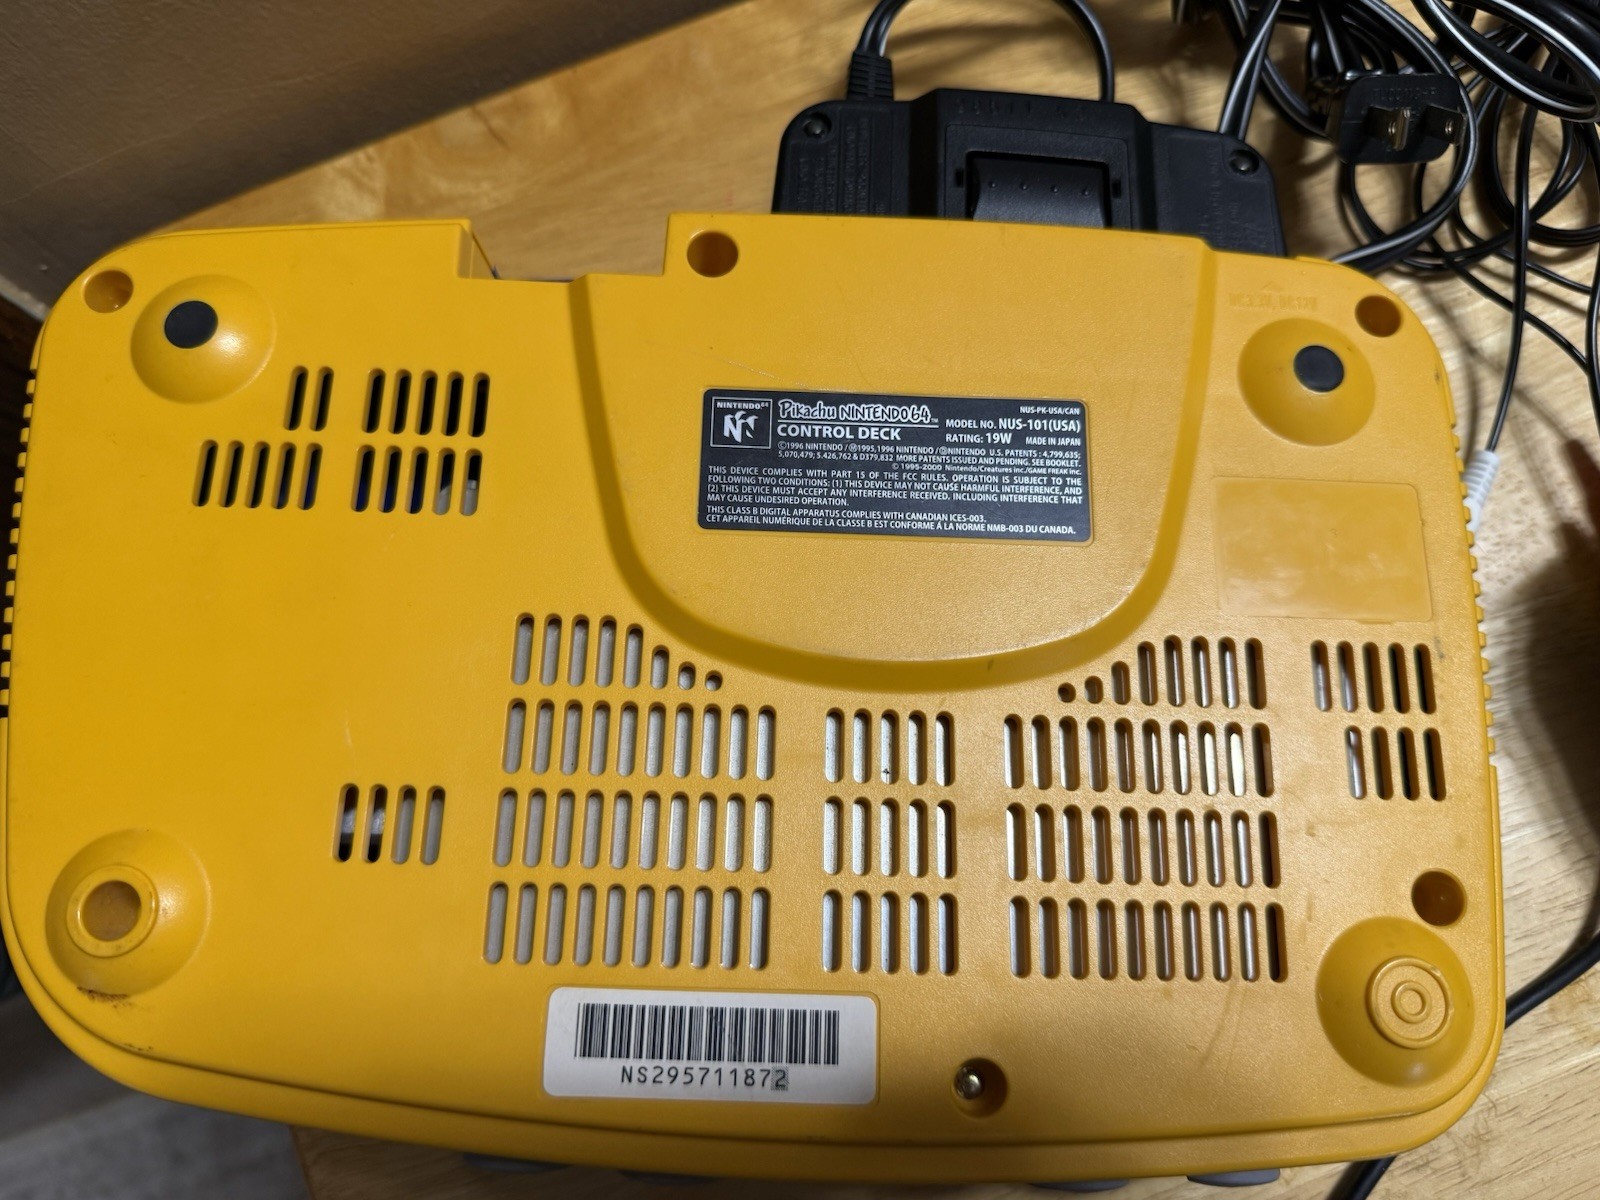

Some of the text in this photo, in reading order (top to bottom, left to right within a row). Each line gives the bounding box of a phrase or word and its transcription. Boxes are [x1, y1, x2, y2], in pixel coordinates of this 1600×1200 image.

[777, 398, 837, 420] Pikachu
[1020, 406, 1079, 415] NUS-PK-USA/CAN
[776, 423, 901, 440] CONTROL DECK
[945, 417, 1080, 432] MODEL NO. NUS-101(USA)
[945, 432, 1012, 444] RATING: 19W
[1025, 436, 1081, 446] MADE IN JAPAN
[805, 442, 843, 451] NINTENDO
[895, 445, 934, 454] NINTENDO
[989, 448, 1003, 456] U.S.
[1004, 448, 1037, 457] PATENTS
[852, 452, 858, 460] &
[859, 452, 893, 461] D379,832
[895, 453, 917, 462] MORE
[917, 454, 950, 463] PATENTS
[951, 455, 977, 464] ISSUED
[978, 456, 995, 465] AND
[995, 456, 1030, 466] PENDING.
[1031, 458, 1044, 467] SEE
[1045, 458, 1081, 468] BOOKLET.
[900, 462, 942, 470] 1995-2000
[944, 464, 1012, 472] Nintendo/Creatures
[708, 465, 1081, 486] THIS DEVICE COMPLIES WITH PART 15 OF THE FCC RULES. OPERATION IS SUBJECT TO THE
[707, 474, 1082, 495] FOLLOWING TWO CONDITIONS: (1) THIS DEVICE MAY NOT CAUSE HARMFUL INTERFERENCE, AND
[706, 493, 849, 506] MAY CAUSE UNDESIRED OPERATION.
[707, 483, 718, 492] (2)
[720, 484, 739, 493] THIS
[741, 484, 770, 494] DEVICE
[772, 486, 795, 494] MUST
[797, 486, 828, 496] ACCEPT
[830, 488, 847, 496] ANY
[849, 488, 907, 499] INTERFERENCE
[952, 492, 998, 502] INCLUDING
[999, 493, 1058, 503] INTERFERENCE
[1060, 495, 1082, 504] THAT
[706, 505, 986, 522] THIS CLASS B DIGITAL APPARATUS COMPLIES WITH CANADIAN ICES-003.
[705, 514, 721, 522] CET
[722, 514, 761, 524] APPAREIL
[762, 515, 810, 525] NUMÉRIQUE
[812, 517, 822, 525] DE
[824, 518, 835, 526] LA
[836, 518, 865, 527] CLASSE
[866, 519, 872, 527] B
[873, 519, 888, 528] EST
[889, 520, 935, 530] CONFORME
[943, 522, 954, 530] LA
[955, 522, 985, 531] NORME
[986, 523, 1023, 532] NMB-003
[1025, 524, 1037, 533] DU
[1038, 524, 1075, 534] CANADA.
[620, 1066, 788, 1090] NS295711872
